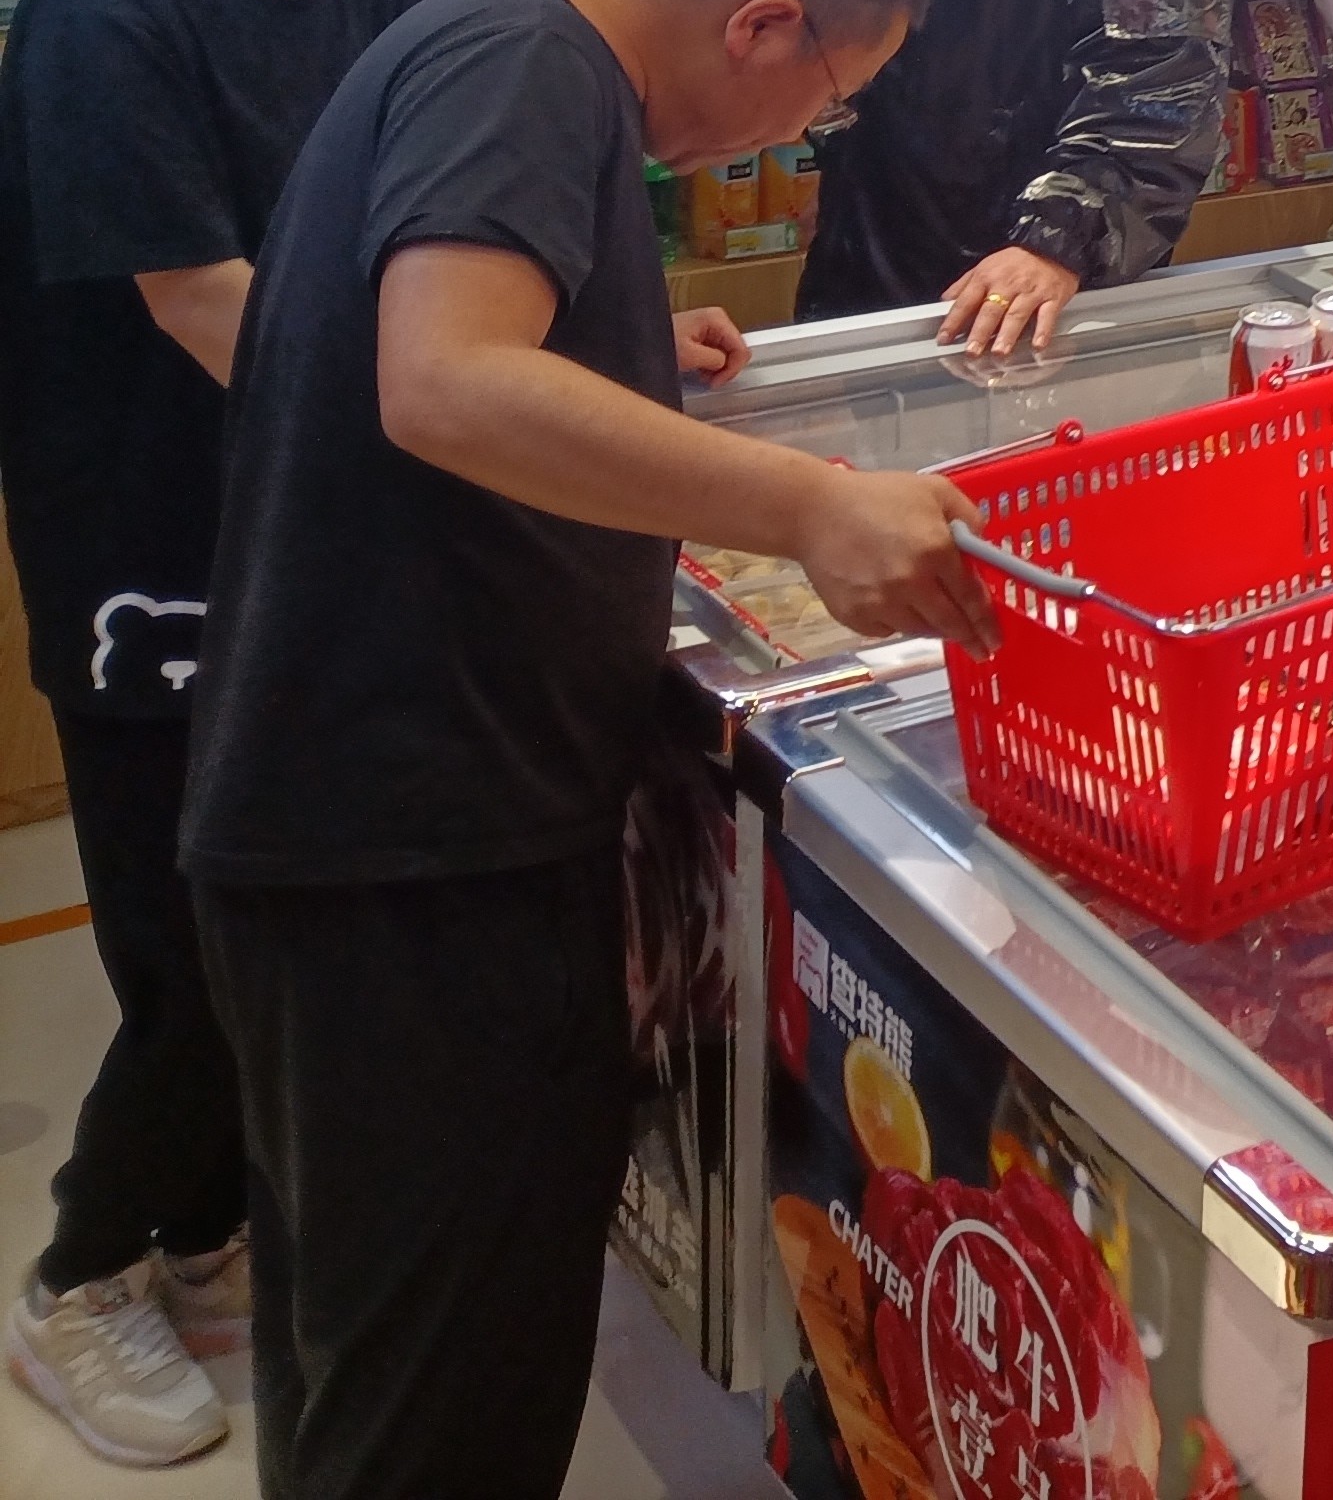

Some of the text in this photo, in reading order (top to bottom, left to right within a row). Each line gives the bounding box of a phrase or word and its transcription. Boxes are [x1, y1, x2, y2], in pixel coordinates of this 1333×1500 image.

[831, 952, 914, 1081] 查特熊
[829, 1200, 915, 1322] CHATER
[952, 1249, 1060, 1428] 肥牛
